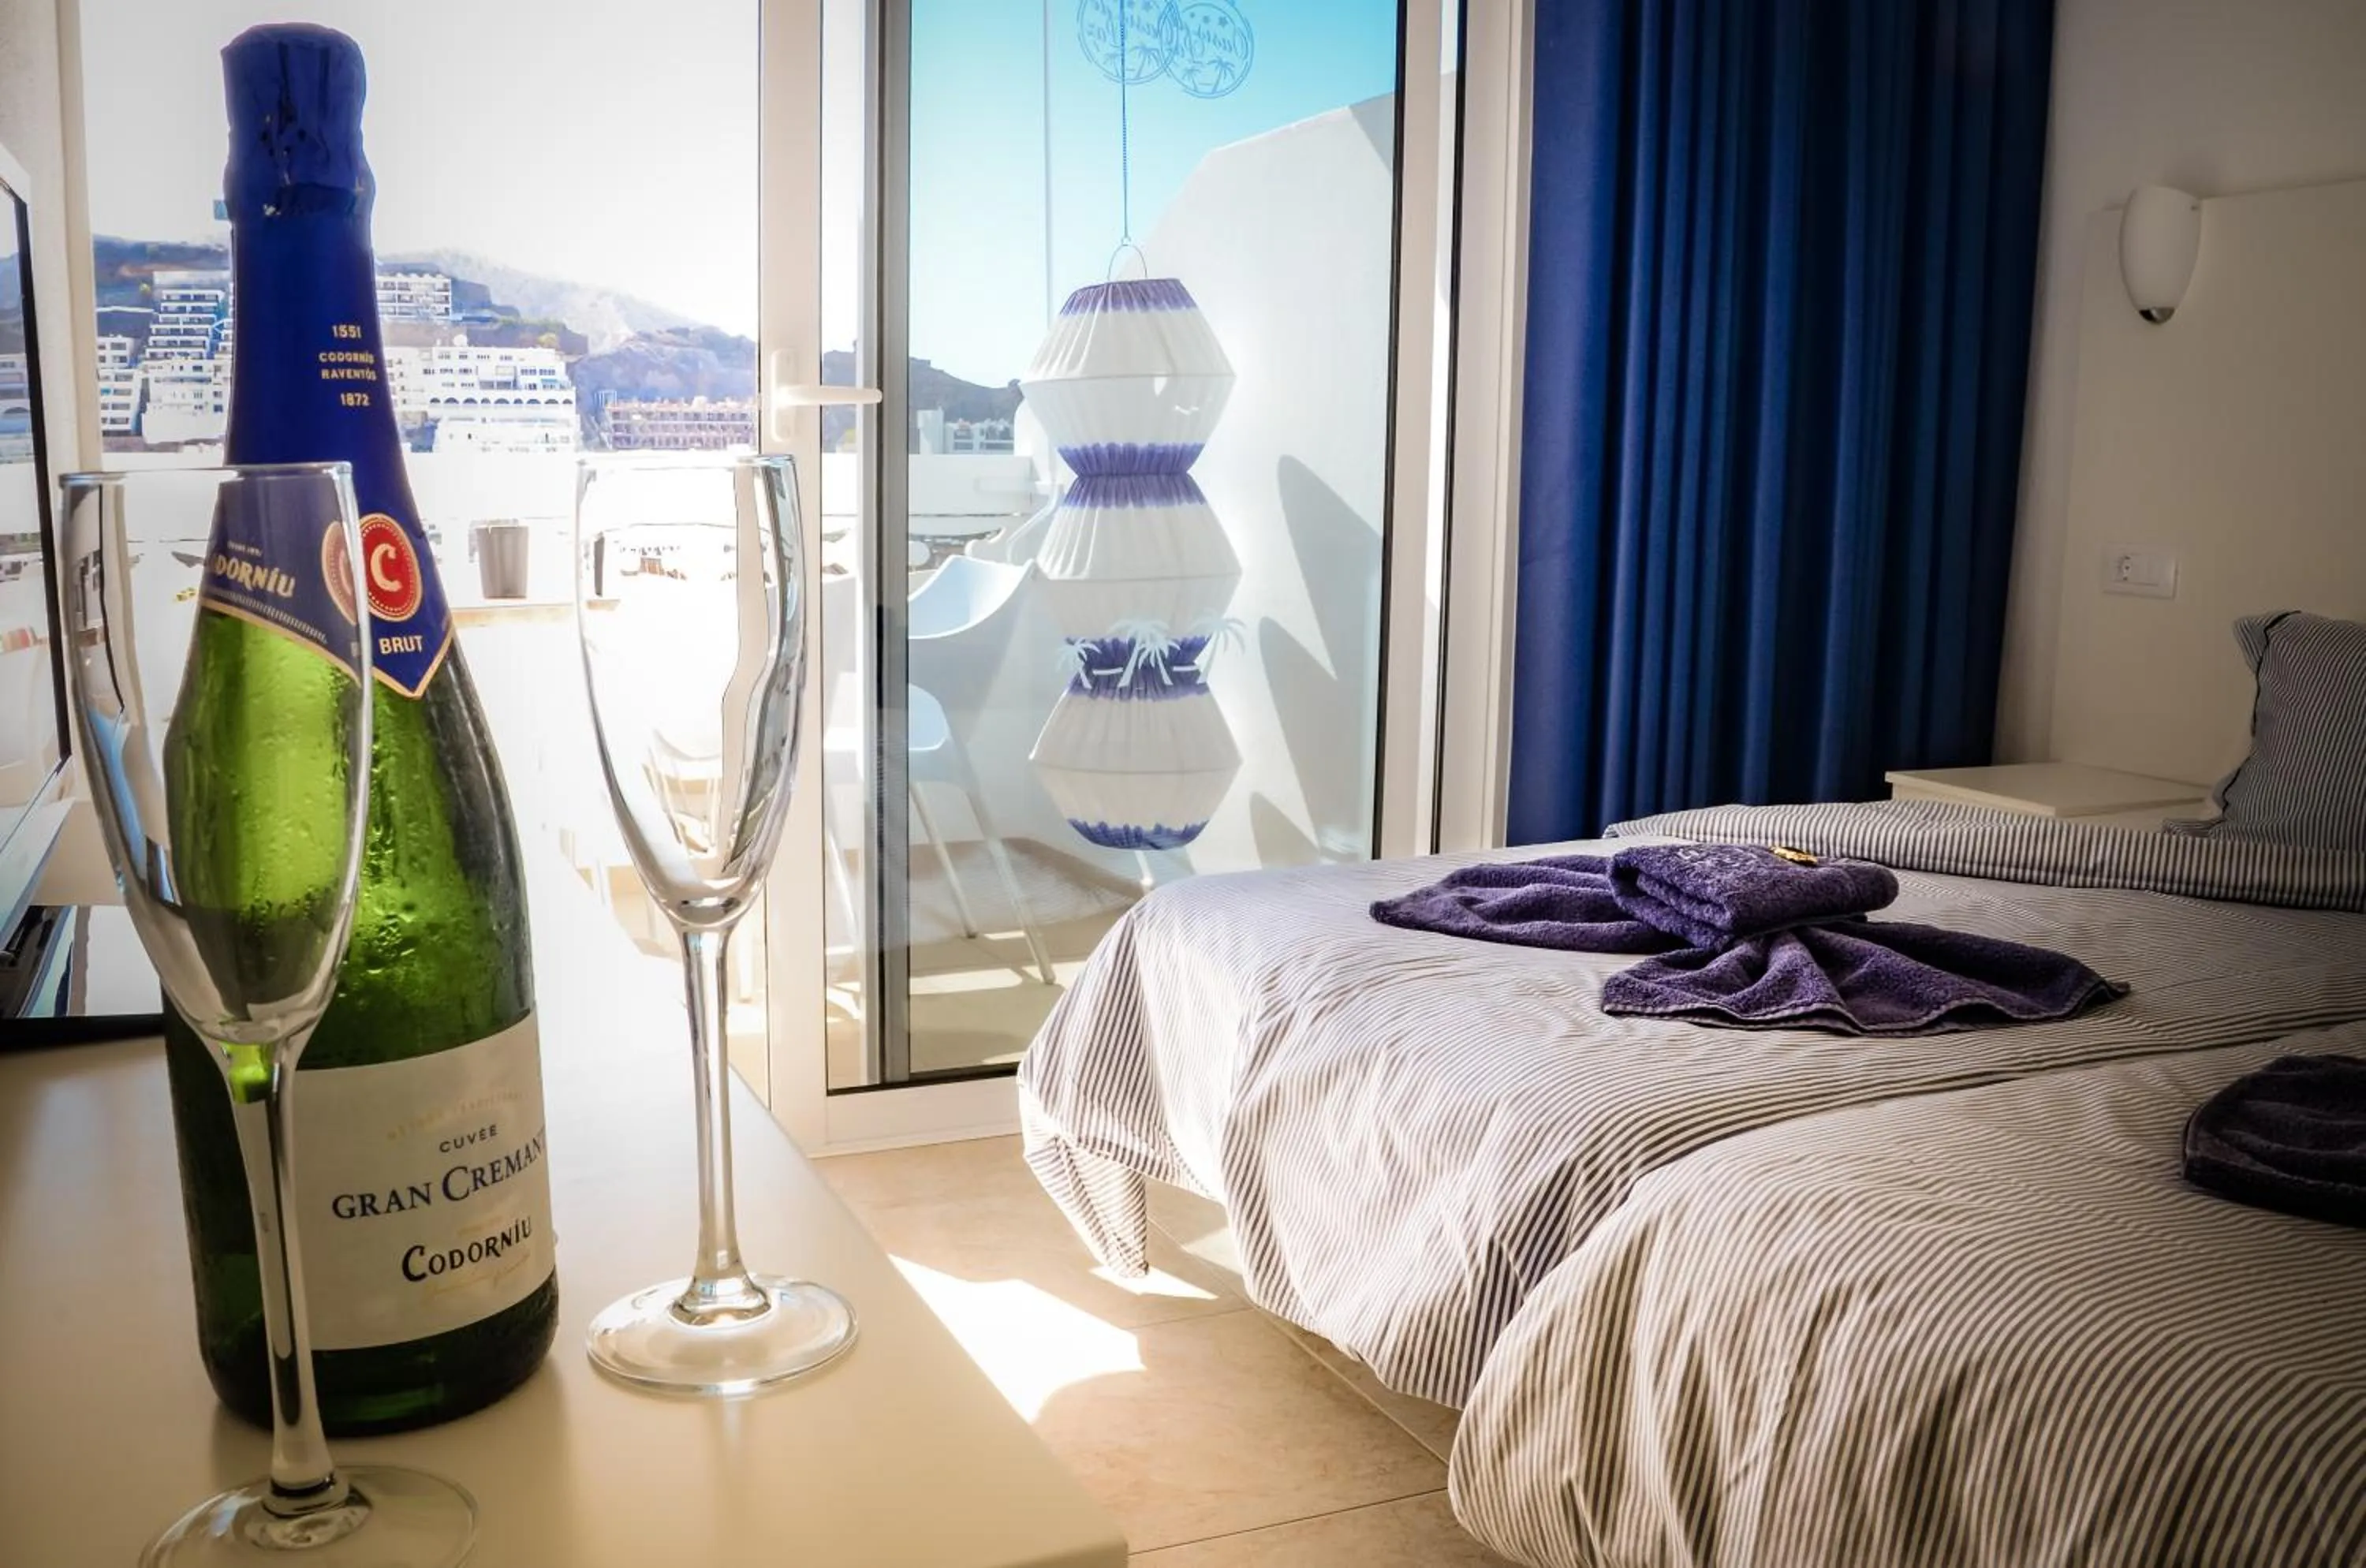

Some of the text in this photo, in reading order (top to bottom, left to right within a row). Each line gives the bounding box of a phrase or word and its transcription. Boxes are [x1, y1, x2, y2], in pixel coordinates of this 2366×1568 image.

[332, 324, 361, 338] 1551
[340, 393, 370, 406] 1872
[371, 543, 403, 592] C
[379, 635, 424, 654] BRUT
[439, 1124, 498, 1153] CUVÉE
[332, 1182, 433, 1219] GRAN
